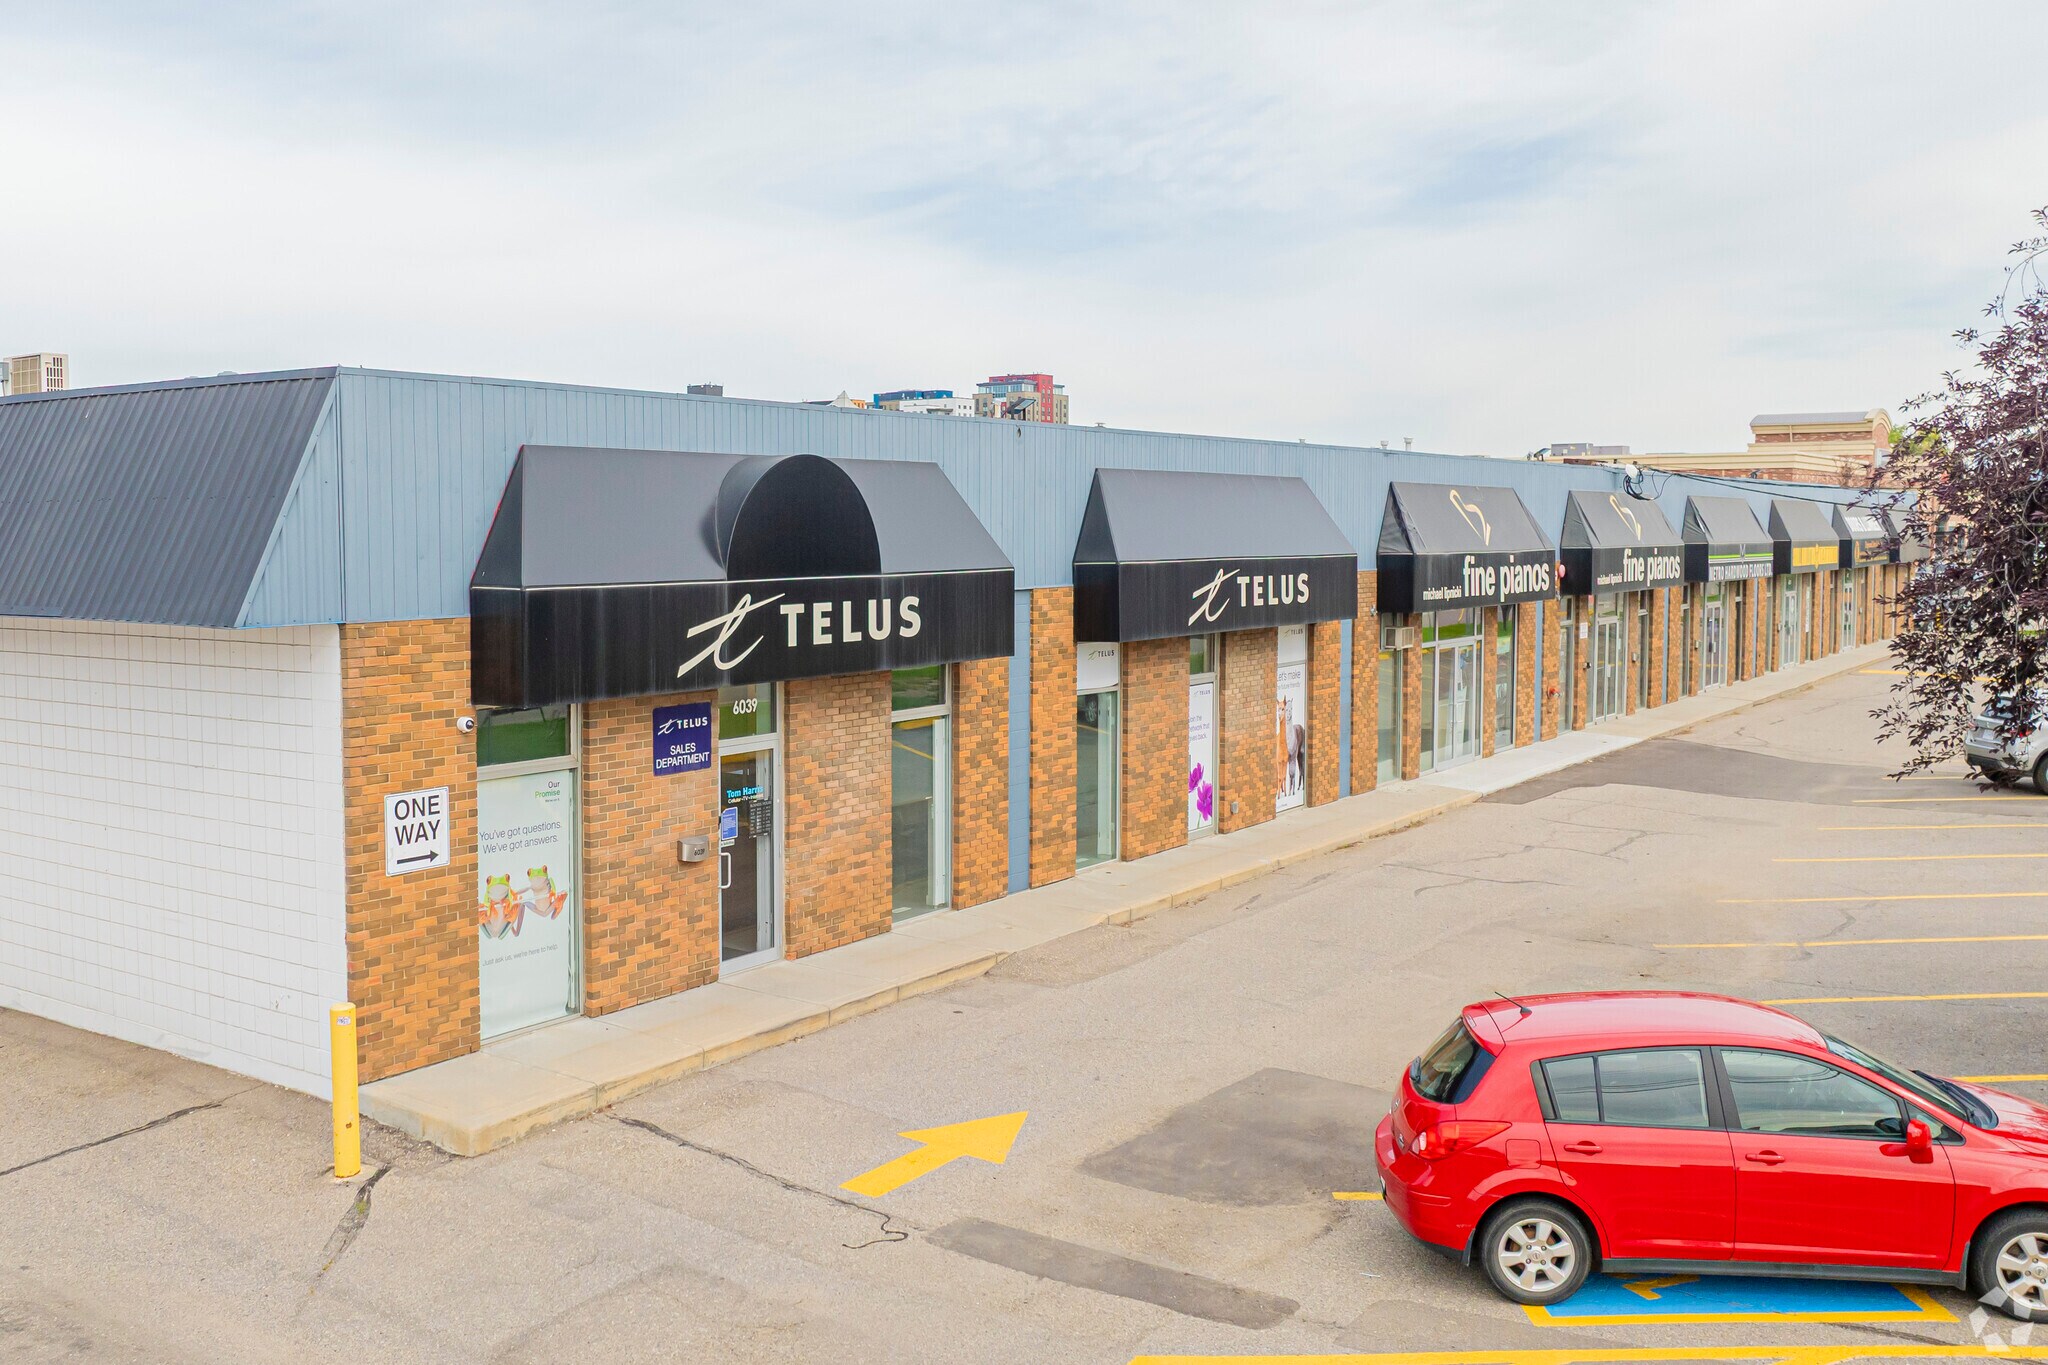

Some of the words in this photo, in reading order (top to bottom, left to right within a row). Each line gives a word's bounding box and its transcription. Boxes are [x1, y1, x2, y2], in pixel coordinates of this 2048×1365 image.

[1623, 548, 1645, 582] fine
[1646, 547, 1681, 587] pianos
[1463, 554, 1496, 597] fine
[1500, 554, 1550, 603] pianos
[1236, 572, 1310, 607] TELUS
[780, 595, 922, 647] TELUS
[1097, 649, 1115, 658] TELUS
[732, 698, 758, 715] 6039
[677, 716, 708, 730] TELUS
[670, 742, 697, 756] SALES
[656, 751, 710, 769] DEPARTMENT
[547, 781, 561, 789] Our
[726, 789, 742, 799] Tom
[742, 786, 765, 796] Harris
[534, 790, 561, 799] Promise
[394, 794, 441, 821] ONE
[394, 819, 441, 846] WAY
[479, 830, 506, 842] You've
[507, 827, 521, 840] got
[482, 842, 508, 854] We've
[509, 840, 523, 852] got
